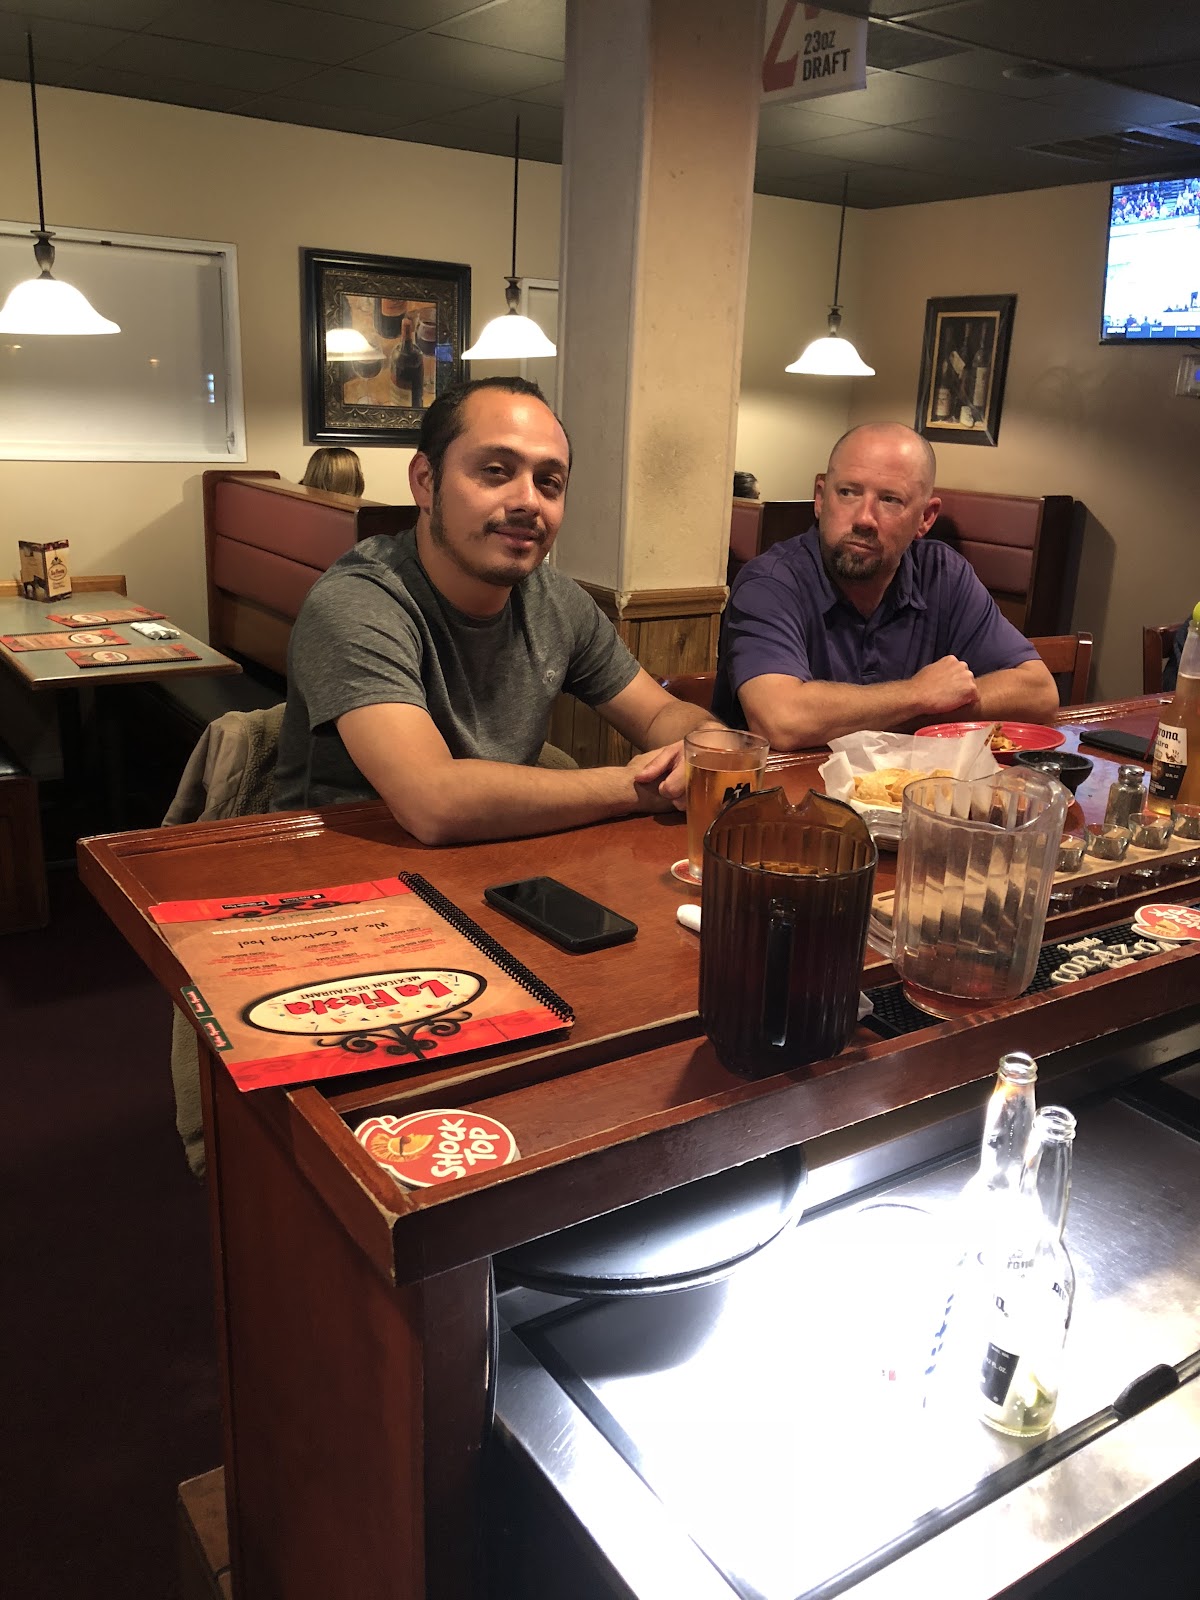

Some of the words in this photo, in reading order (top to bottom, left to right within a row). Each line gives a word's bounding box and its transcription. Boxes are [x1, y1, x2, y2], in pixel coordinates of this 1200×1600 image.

[803, 48, 851, 81] DRAFT
[364, 921, 389, 930] We
[236, 939, 265, 949] too!
[270, 929, 338, 944] Catering
[373, 975, 421, 988] MEXICAN
[394, 978, 454, 999] La
[299, 983, 371, 1001] RESTAURANT
[283, 988, 400, 1016] Fiesta
